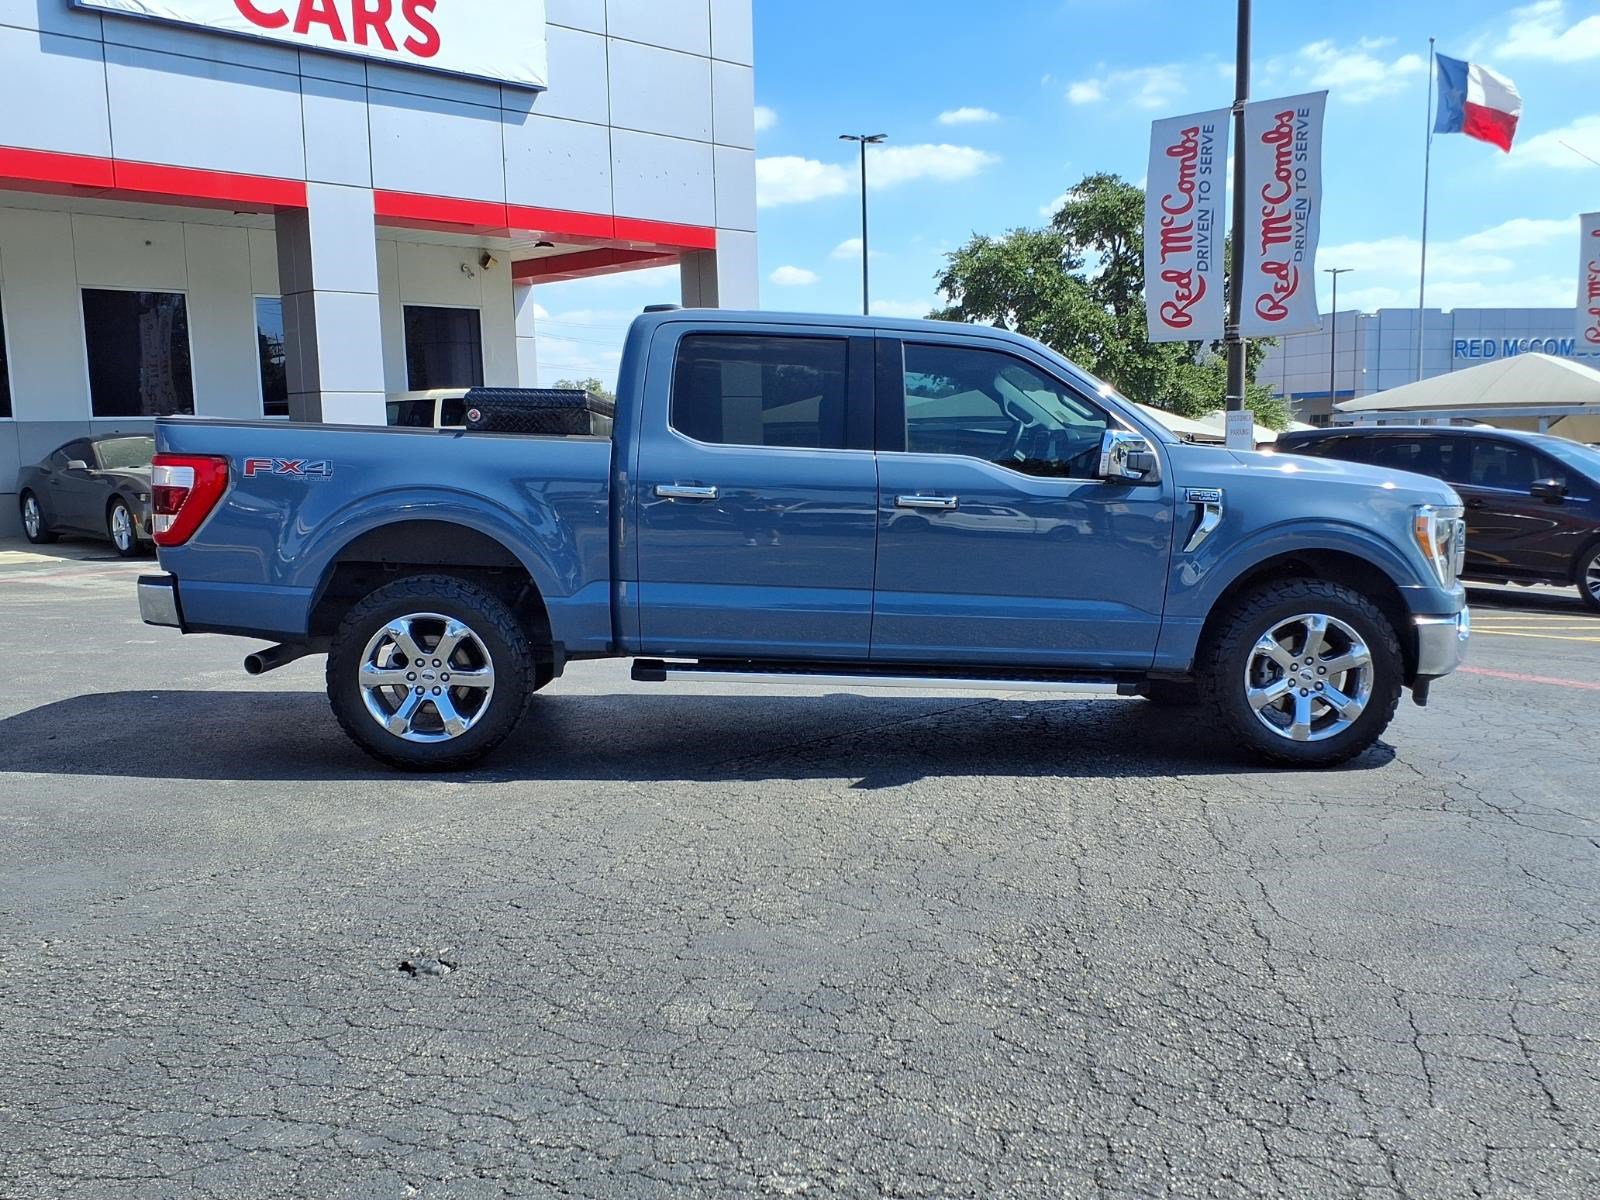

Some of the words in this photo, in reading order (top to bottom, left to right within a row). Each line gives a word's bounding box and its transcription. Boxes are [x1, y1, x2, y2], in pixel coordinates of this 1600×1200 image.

[1200, 124, 1215, 176] SERVE
[1296, 107, 1310, 162] SERVE
[1160, 126, 1200, 265] McCombs
[1198, 181, 1212, 203] TO
[1261, 110, 1296, 257] McCombs
[1295, 167, 1308, 191] TO
[1197, 209, 1211, 272] DRIVEN
[1294, 198, 1308, 262] DRIVEN
[1160, 267, 1207, 328] Red
[1255, 259, 1299, 321] Red
[1454, 339, 1496, 358] RED
[243, 457, 332, 478] FX4
